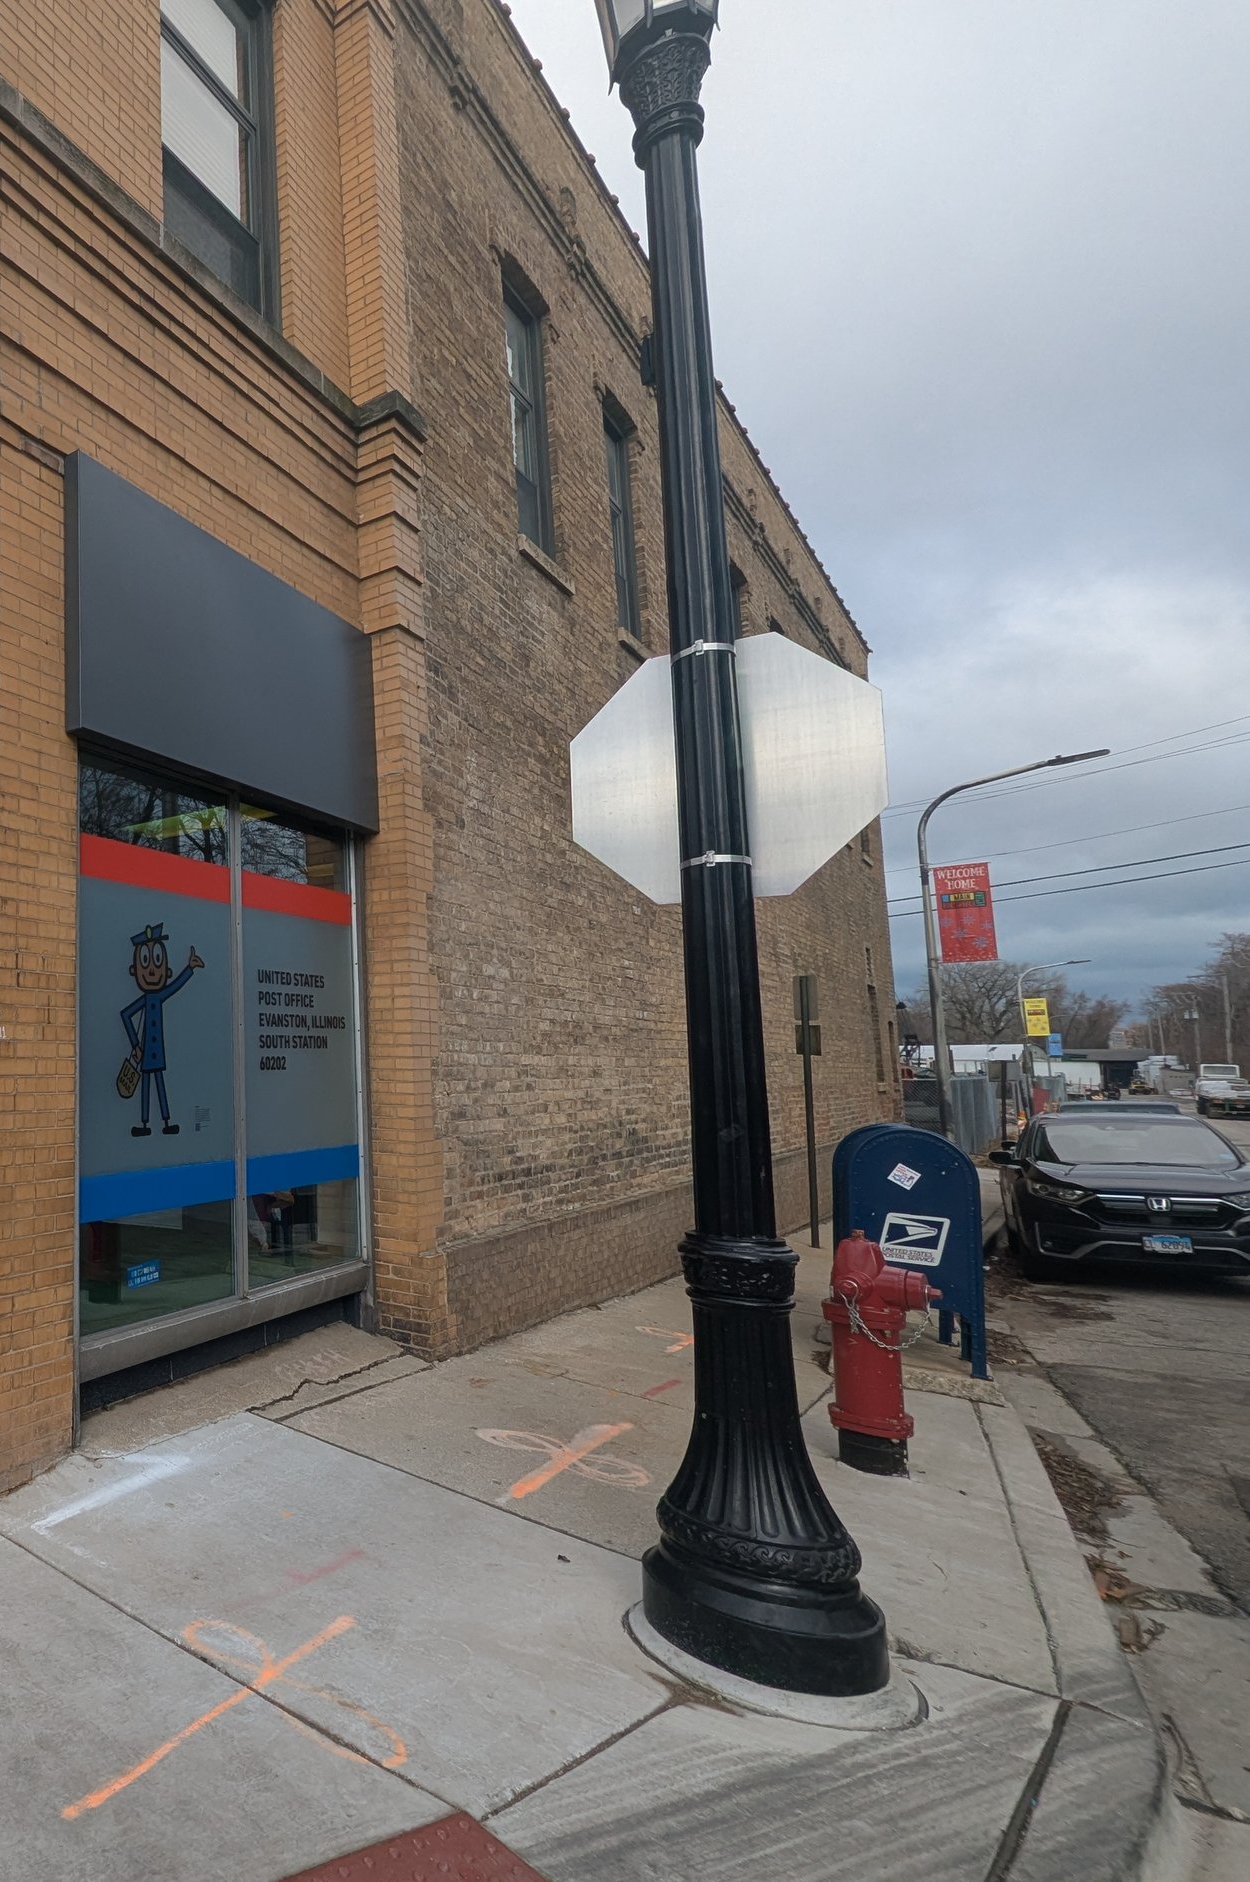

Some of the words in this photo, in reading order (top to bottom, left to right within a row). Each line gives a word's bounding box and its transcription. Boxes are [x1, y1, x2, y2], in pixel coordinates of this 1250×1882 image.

[937, 866, 986, 880] WELCOME
[944, 879, 976, 890] HOME
[257, 969, 291, 986] UNITED
[293, 973, 325, 989] STATES
[258, 991, 282, 1006] POST
[284, 993, 314, 1008] OFFICE
[259, 1013, 310, 1031] EVANSTON,
[311, 1015, 346, 1029] ILLINOIS
[259, 1034, 290, 1049] SOUTH
[292, 1035, 328, 1049] STATION
[259, 1056, 286, 1071] 60202
[882, 1246, 907, 1255] UNITED
[908, 1249, 933, 1258] STATES
